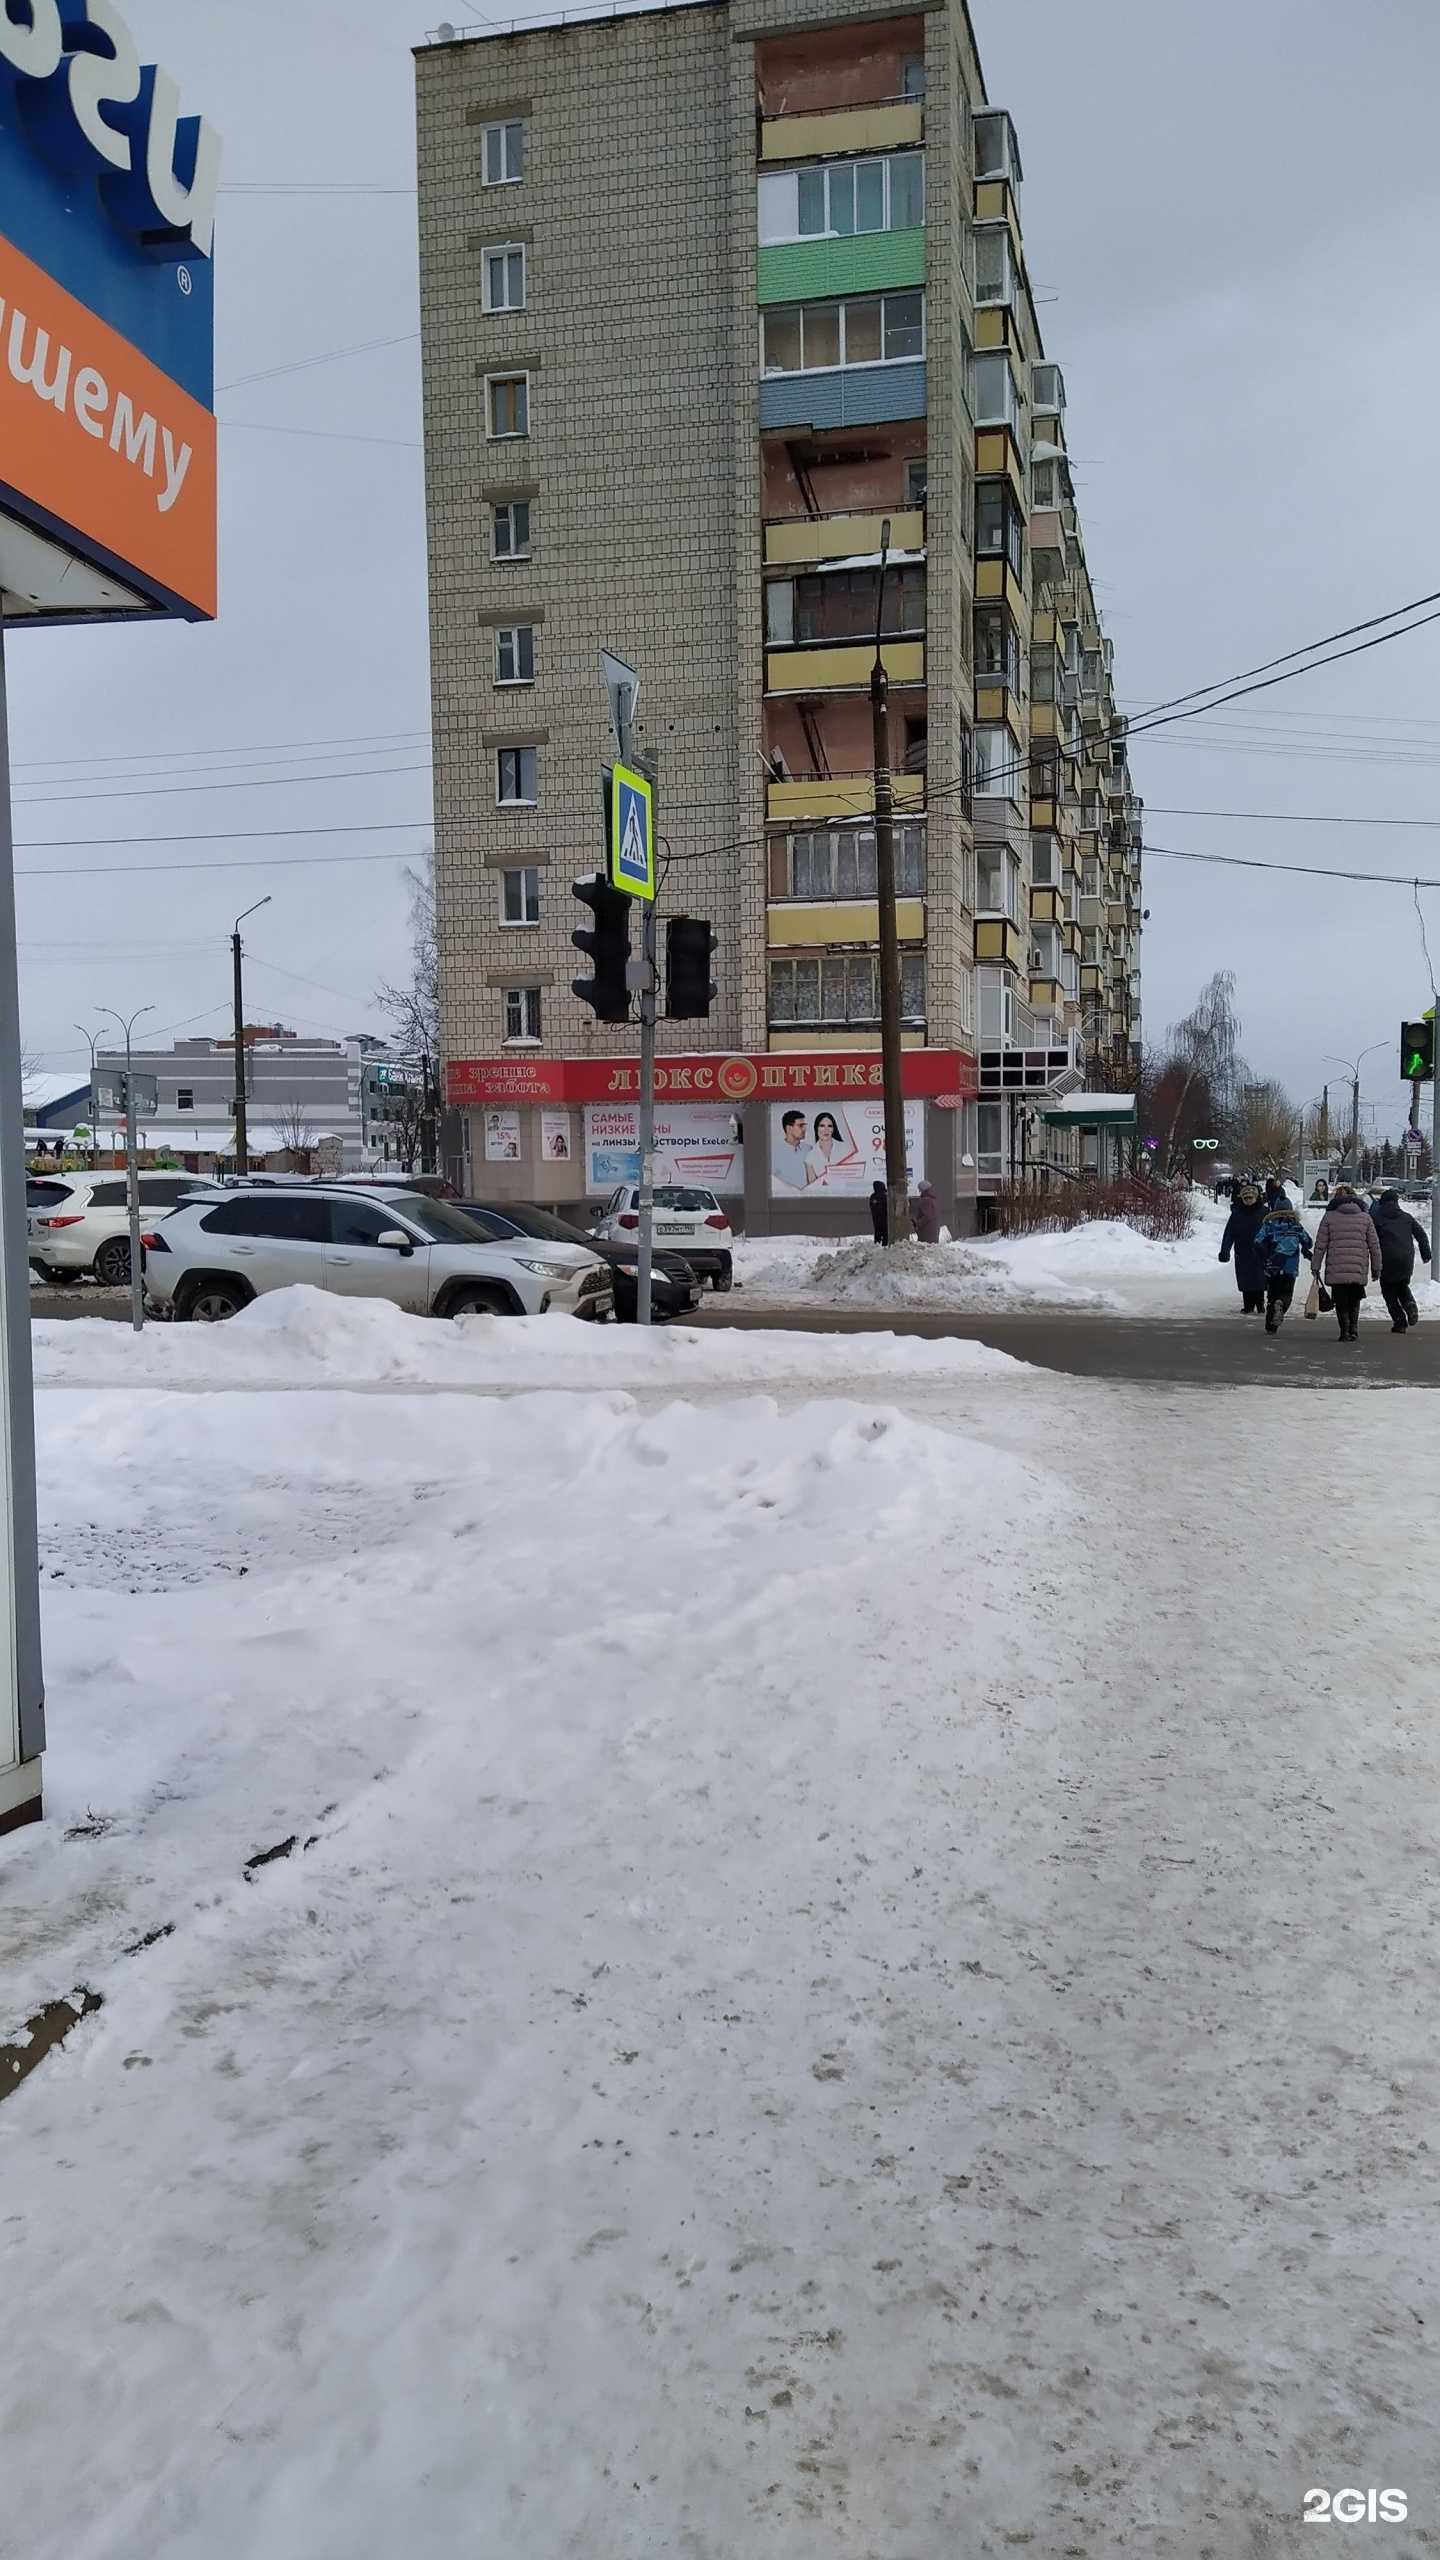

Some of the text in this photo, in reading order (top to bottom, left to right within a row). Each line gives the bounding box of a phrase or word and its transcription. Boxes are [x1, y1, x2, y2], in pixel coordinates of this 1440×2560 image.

[0, 296, 193, 513] шему
[484, 1078, 551, 1094] забота
[591, 1112, 634, 1123] САМЫЕ
[591, 1123, 672, 1135] НИЗКИЕ НЫ
[602, 1138, 636, 1147] линзы
[655, 1137, 700, 1147] створы
